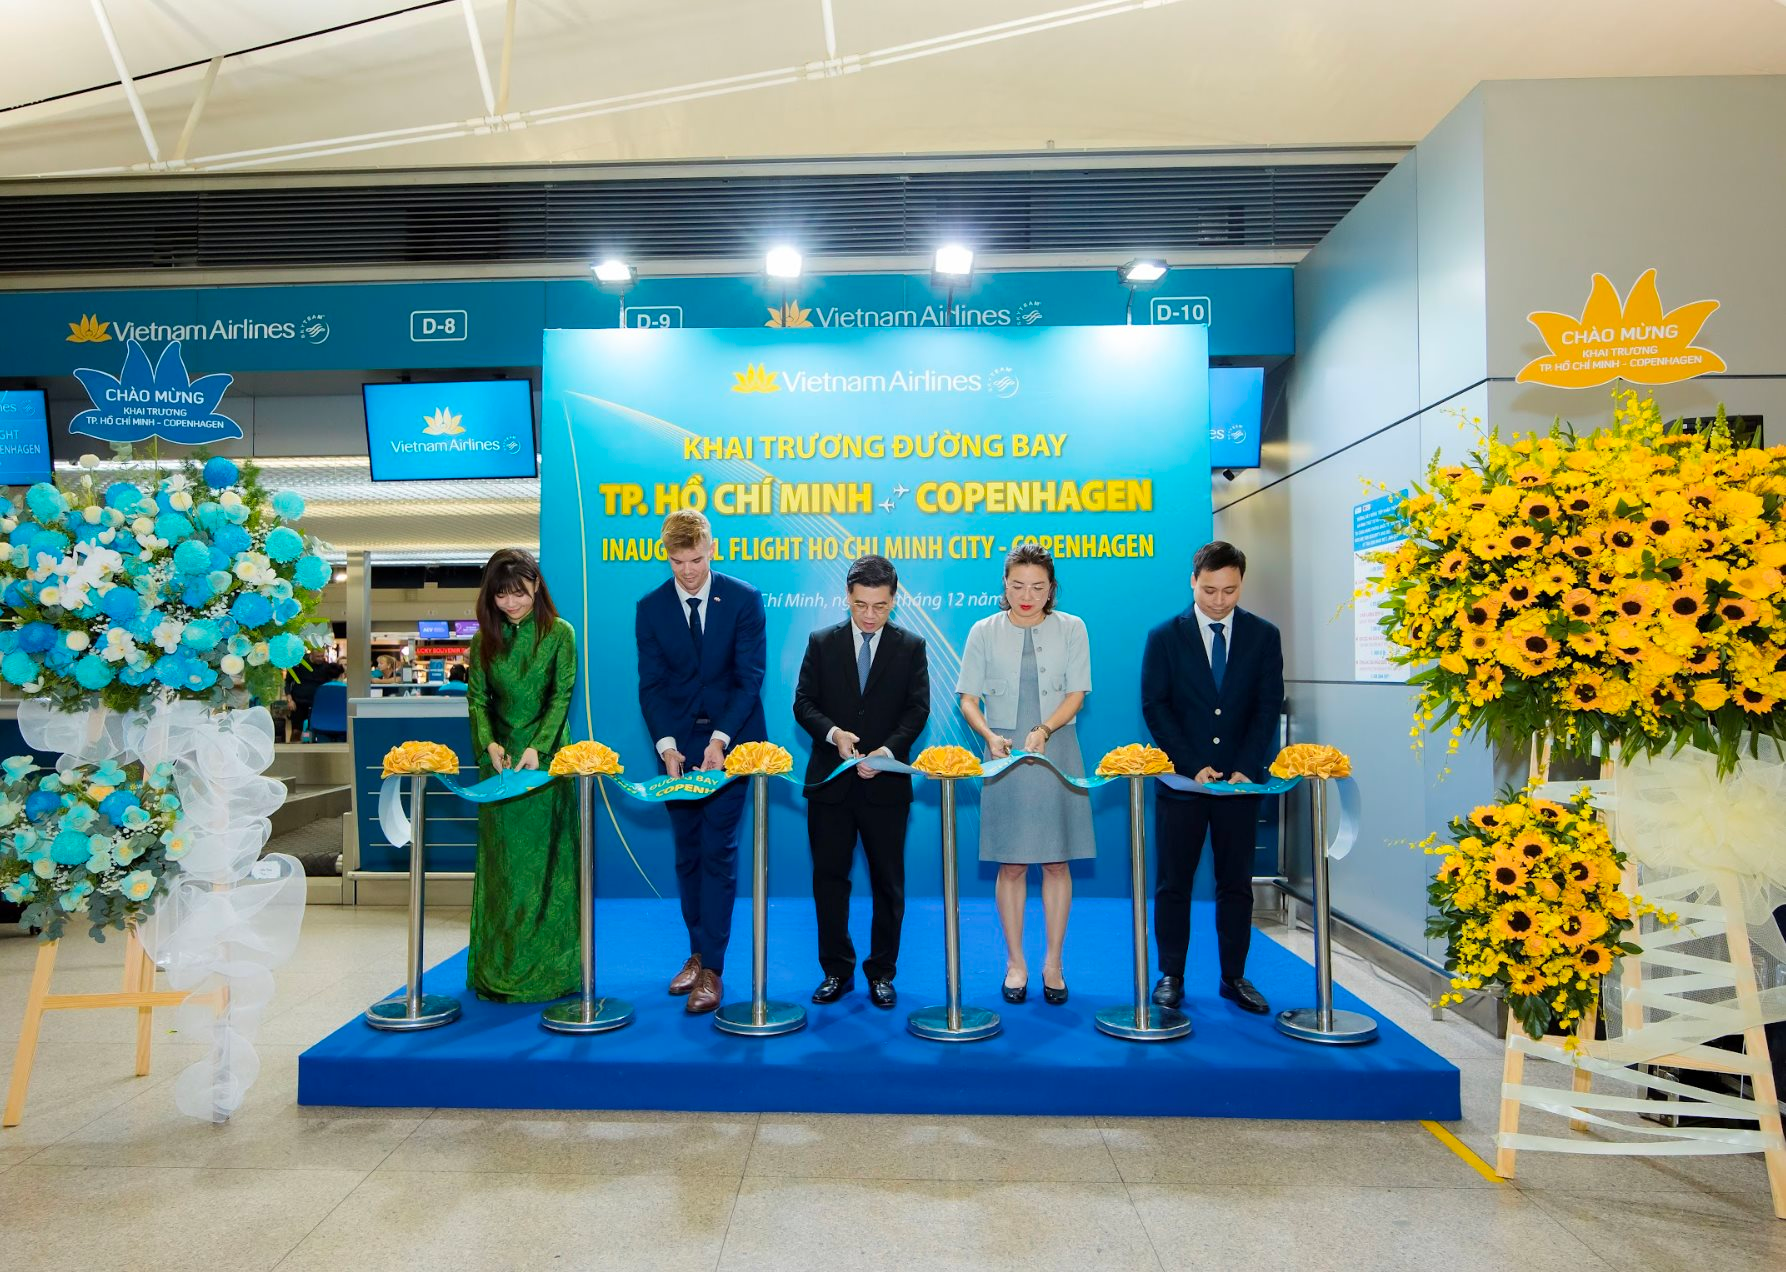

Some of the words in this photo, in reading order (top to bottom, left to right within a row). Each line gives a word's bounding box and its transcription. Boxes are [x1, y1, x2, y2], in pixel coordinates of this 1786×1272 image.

[817, 306, 917, 328] Vietnam
[920, 304, 1011, 326] Airlines
[1157, 304, 1205, 321] D-10
[113, 321, 206, 342] Vietnam
[209, 318, 296, 340] Airlines
[422, 317, 456, 335] D-8
[637, 314, 671, 329] D-9
[1561, 326, 1614, 345] CHÀO
[1620, 323, 1679, 341] MỪNG
[1582, 348, 1609, 359] KHAI
[1611, 345, 1659, 358] TRƯƠNG
[1539, 363, 1552, 372] TP.
[1554, 361, 1570, 371] HỒ
[1572, 360, 1591, 371] CHÍ
[1592, 359, 1620, 370] MINH
[1629, 355, 1702, 368] COPENHAGEN
[782, 371, 886, 392] Vietnam
[888, 370, 982, 392] Airlines
[105, 386, 151, 402] CHÀO
[154, 387, 205, 405] MỪNG
[123, 407, 145, 416] KHAI
[147, 407, 187, 417] TRƯƠNG
[86, 416, 98, 425] TP.
[100, 415, 114, 426] HỒ
[115, 416, 131, 426] CHÍ
[132, 417, 155, 427] MINH
[163, 418, 224, 429] COPENHAGEN
[0, 444, 41, 455] ENHAGEN
[391, 440, 448, 453] Vietnam
[449, 438, 501, 451] Airlines
[684, 436, 753, 460] KHAI
[759, 432, 884, 460] TRƯƠNG
[891, 429, 1005, 459] ĐƯỜNG
[1012, 433, 1068, 457] BAY
[599, 483, 649, 516] TP.
[654, 473, 707, 515] HỒ
[713, 475, 774, 515] CHÍ
[779, 482, 873, 515] MINH
[915, 479, 1153, 514] COPENHAGEN
[602, 538, 725, 561] INAUGL
[729, 537, 803, 561] FLIGHT
[808, 538, 839, 560] HO
[843, 537, 878, 560] CHI
[884, 536, 943, 559] MINH
[948, 535, 995, 559] CITY
[785, 592, 828, 609] Minh,
[832, 595, 850, 611] ng
[895, 592, 942, 610] tháng
[948, 592, 965, 607] 12
[967, 591, 1003, 607] năm
[696, 775, 719, 786] BAY
[656, 783, 717, 798] COPENH
